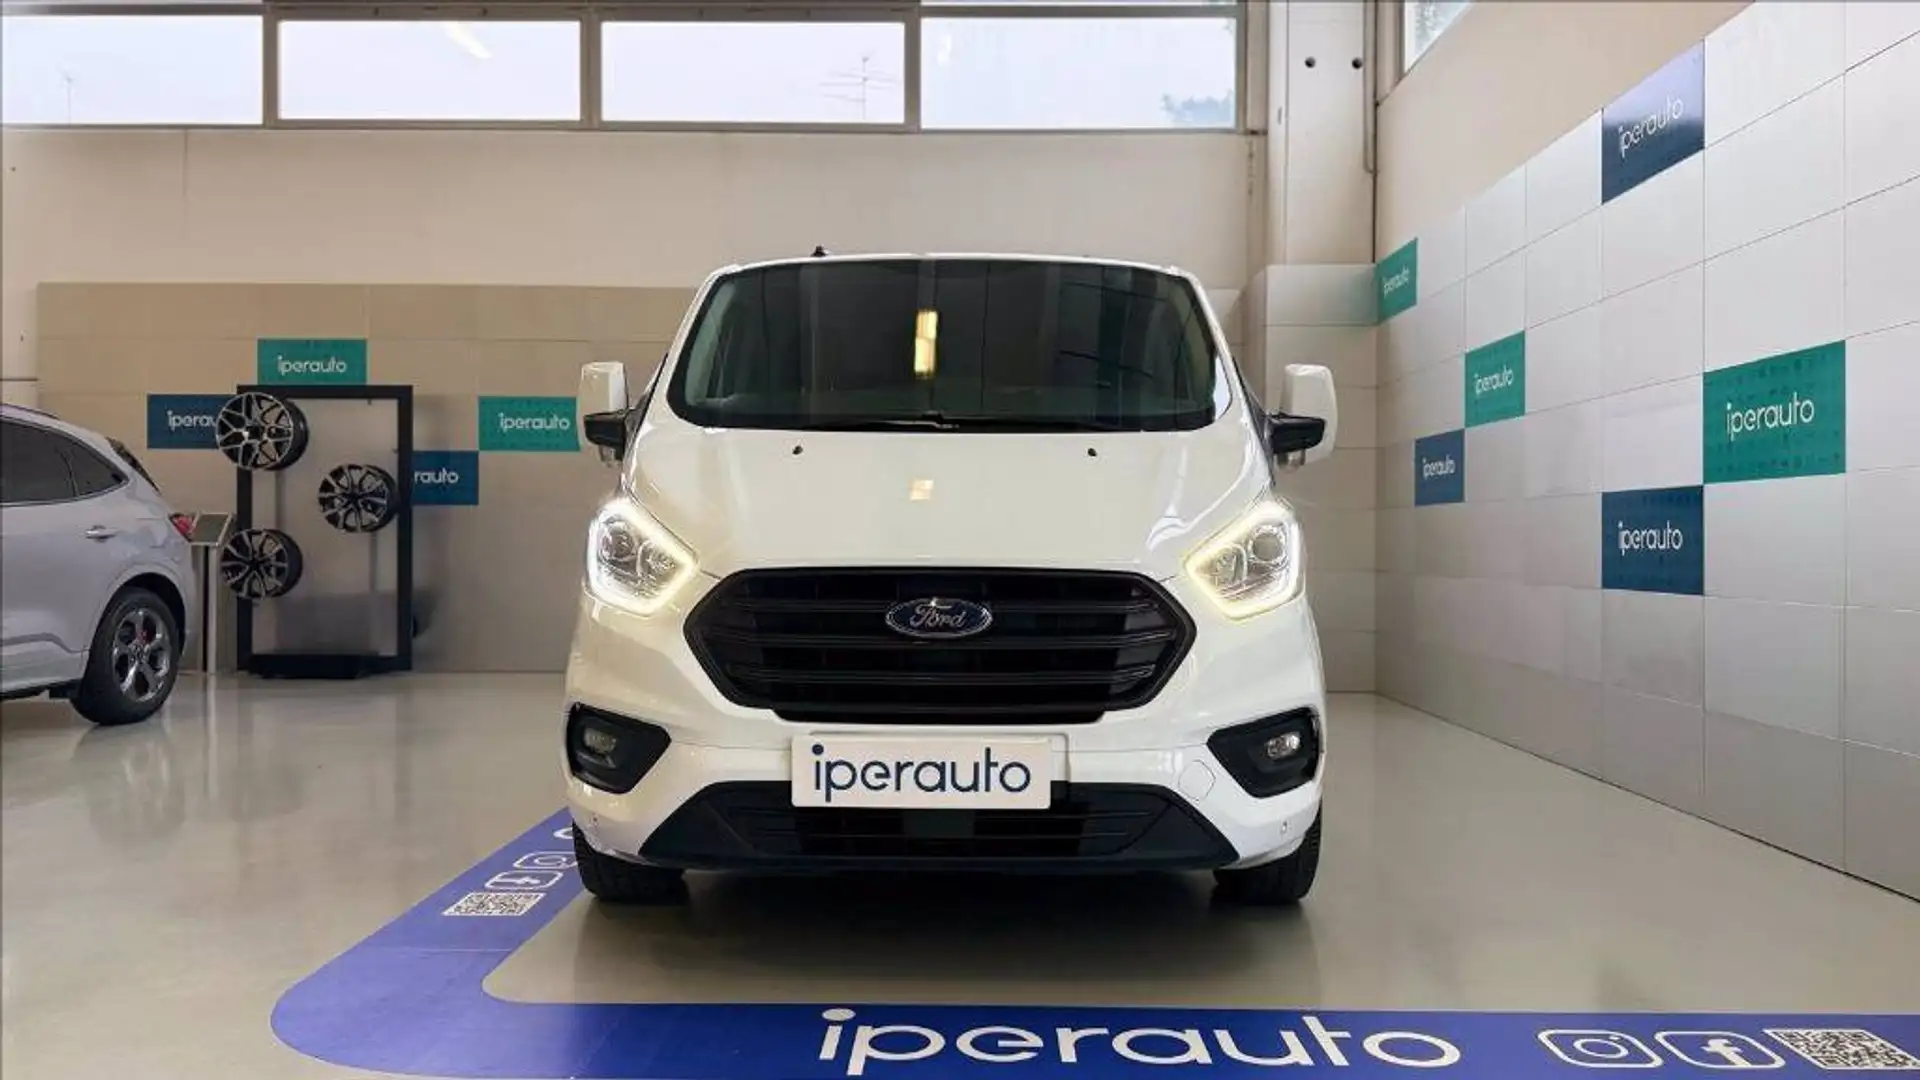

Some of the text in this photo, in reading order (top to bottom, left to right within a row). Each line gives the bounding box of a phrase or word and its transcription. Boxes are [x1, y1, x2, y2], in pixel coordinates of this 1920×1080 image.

[1618, 96, 1685, 157] iperauto
[277, 355, 348, 377] iperauto
[1474, 366, 1513, 396] iperauto
[166, 409, 217, 433] ipera
[500, 412, 570, 434] iperauto
[1726, 391, 1815, 442] iperauto
[414, 467, 460, 485] rauto
[1422, 455, 1456, 479] iperauto
[1617, 521, 1684, 556] iperauto
[909, 602, 967, 629] Ford
[811, 743, 1032, 803] iperauto
[819, 1008, 1462, 1076] iperauto
